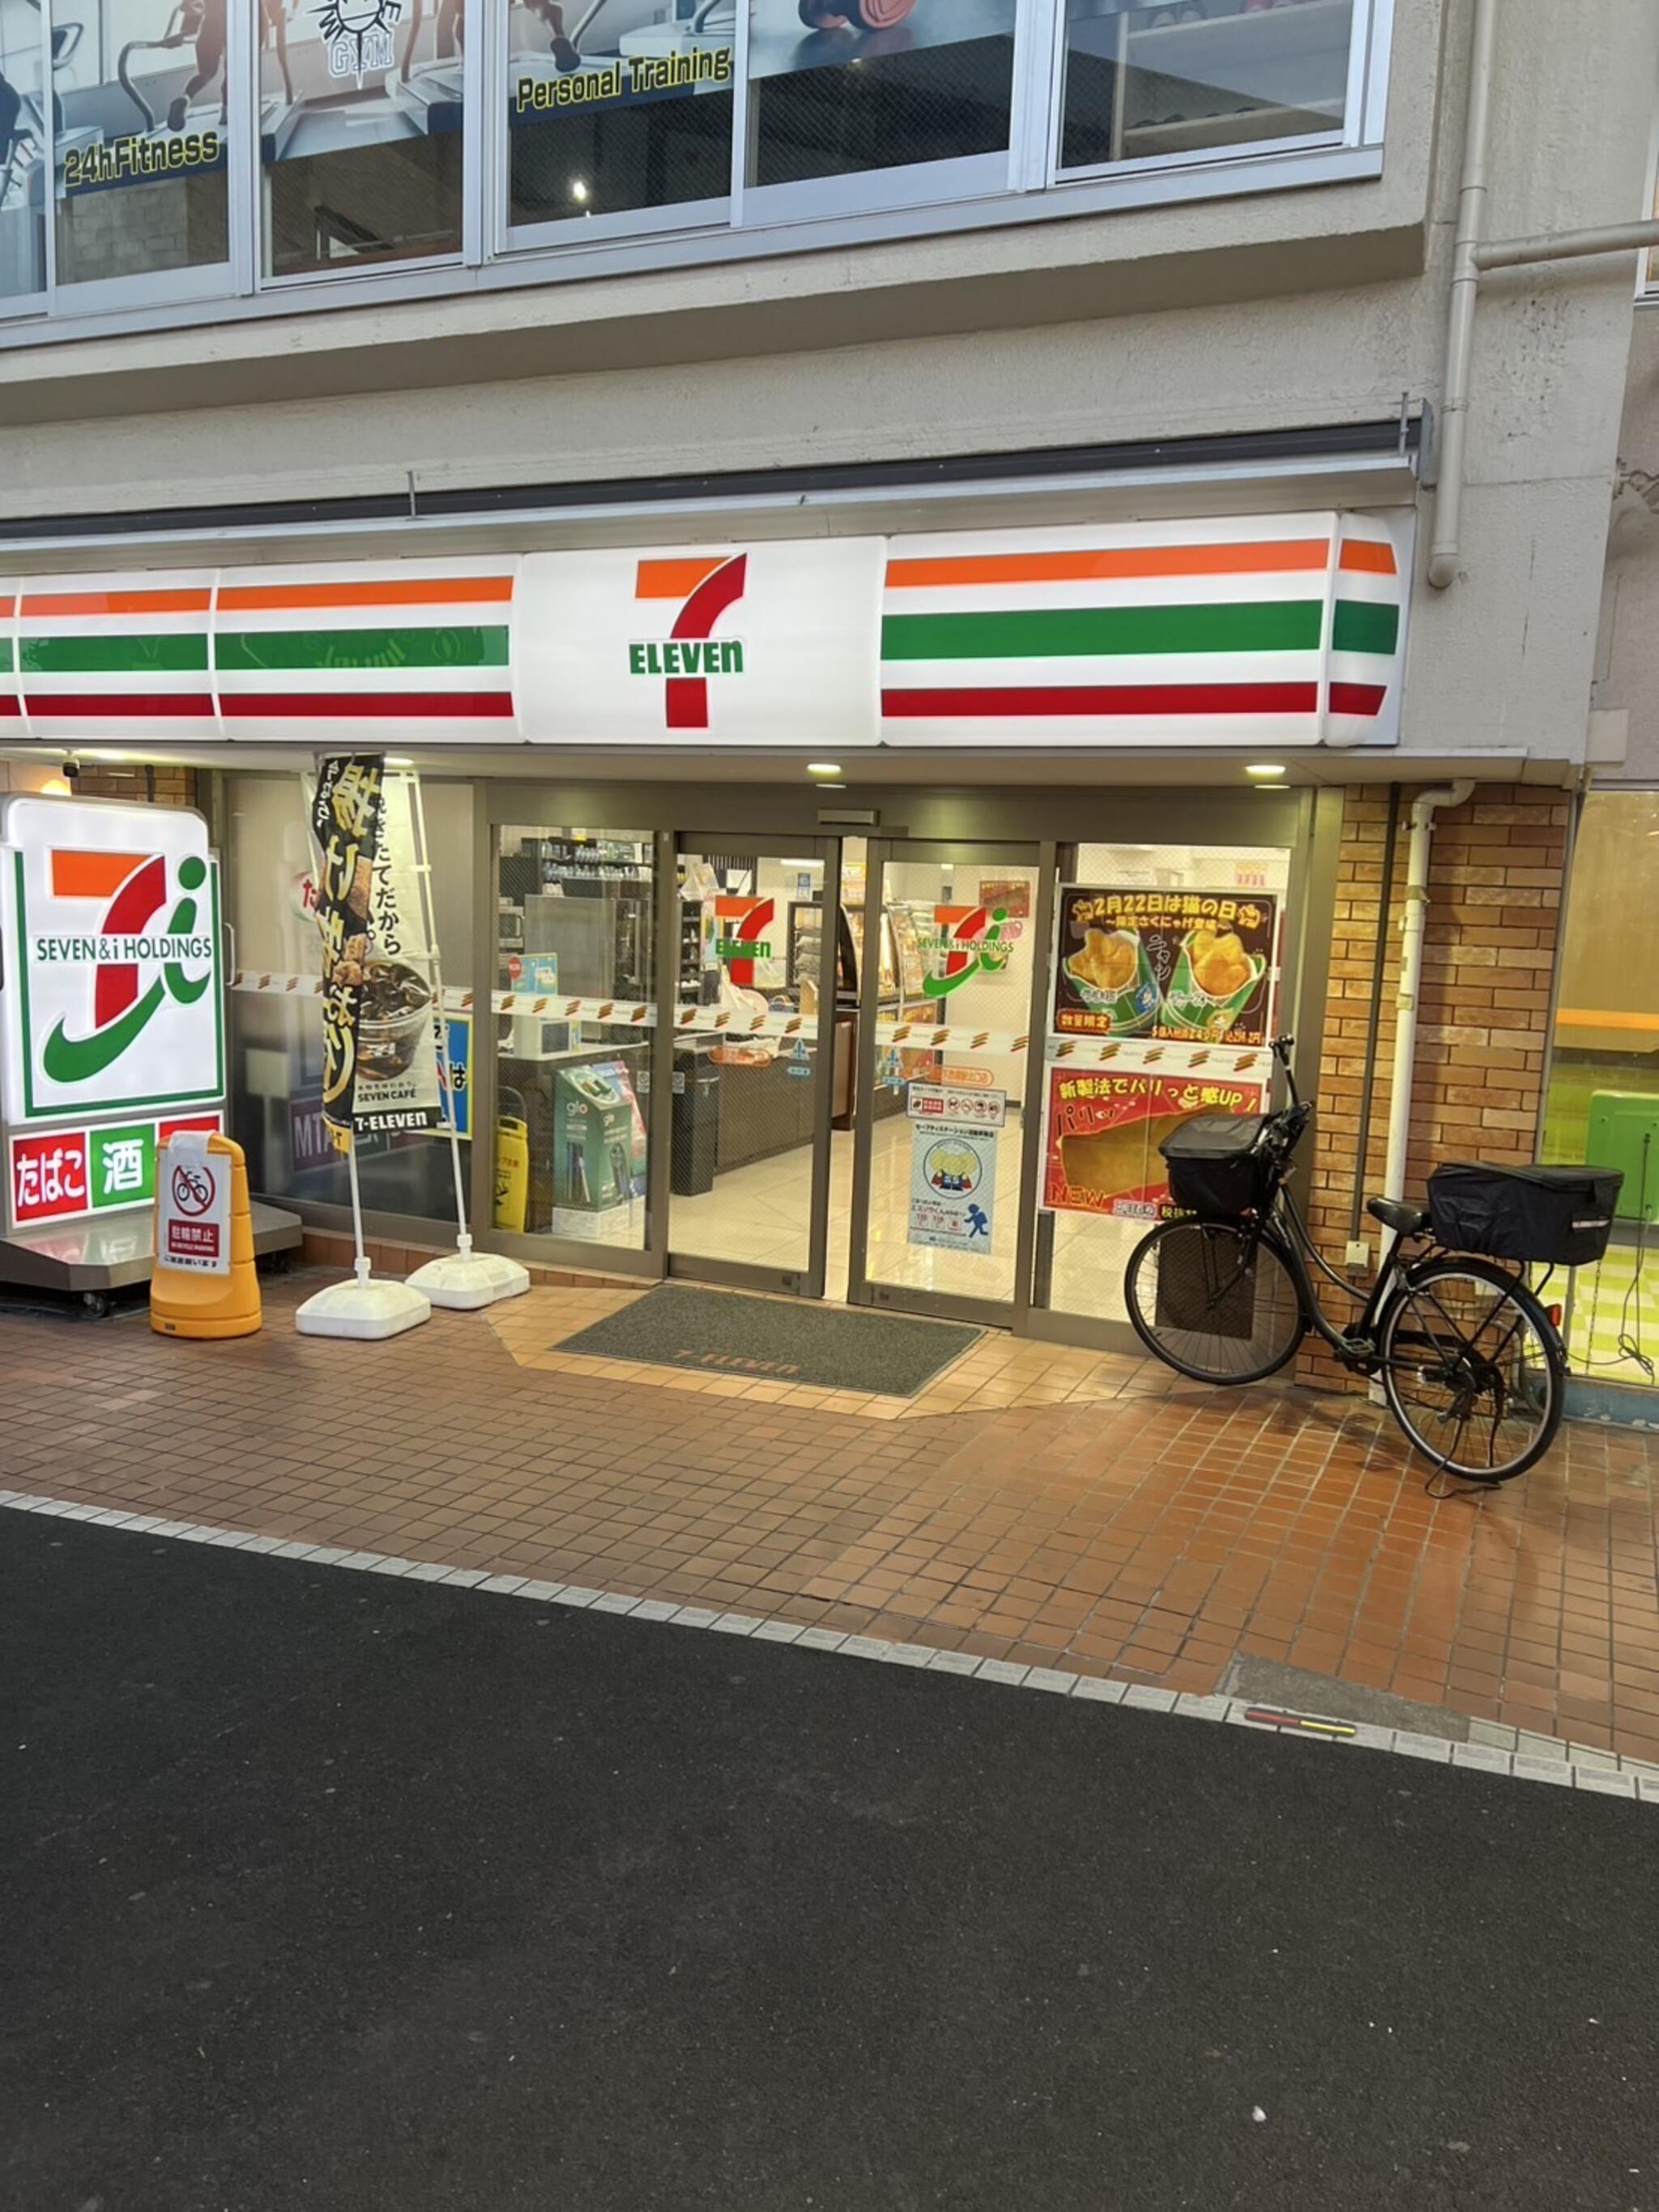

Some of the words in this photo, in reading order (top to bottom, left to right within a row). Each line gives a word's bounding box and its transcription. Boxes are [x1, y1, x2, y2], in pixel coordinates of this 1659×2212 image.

[517, 61, 621, 112] Personal
[629, 47, 731, 92] Training
[1094, 895, 1237, 920] 2月22日は猫の日
[124, 936, 212, 959] HOLDINGS
[962, 940, 1014, 954] HOLDINGS
[358, 1091, 389, 1103] SEVEN
[390, 1088, 416, 1100] CAFÉ
[567, 1100, 588, 1117] glo
[16, 1147, 86, 1208] たばこ
[103, 1140, 144, 1194] 酒
[1051, 1184, 1105, 1208] NEW
